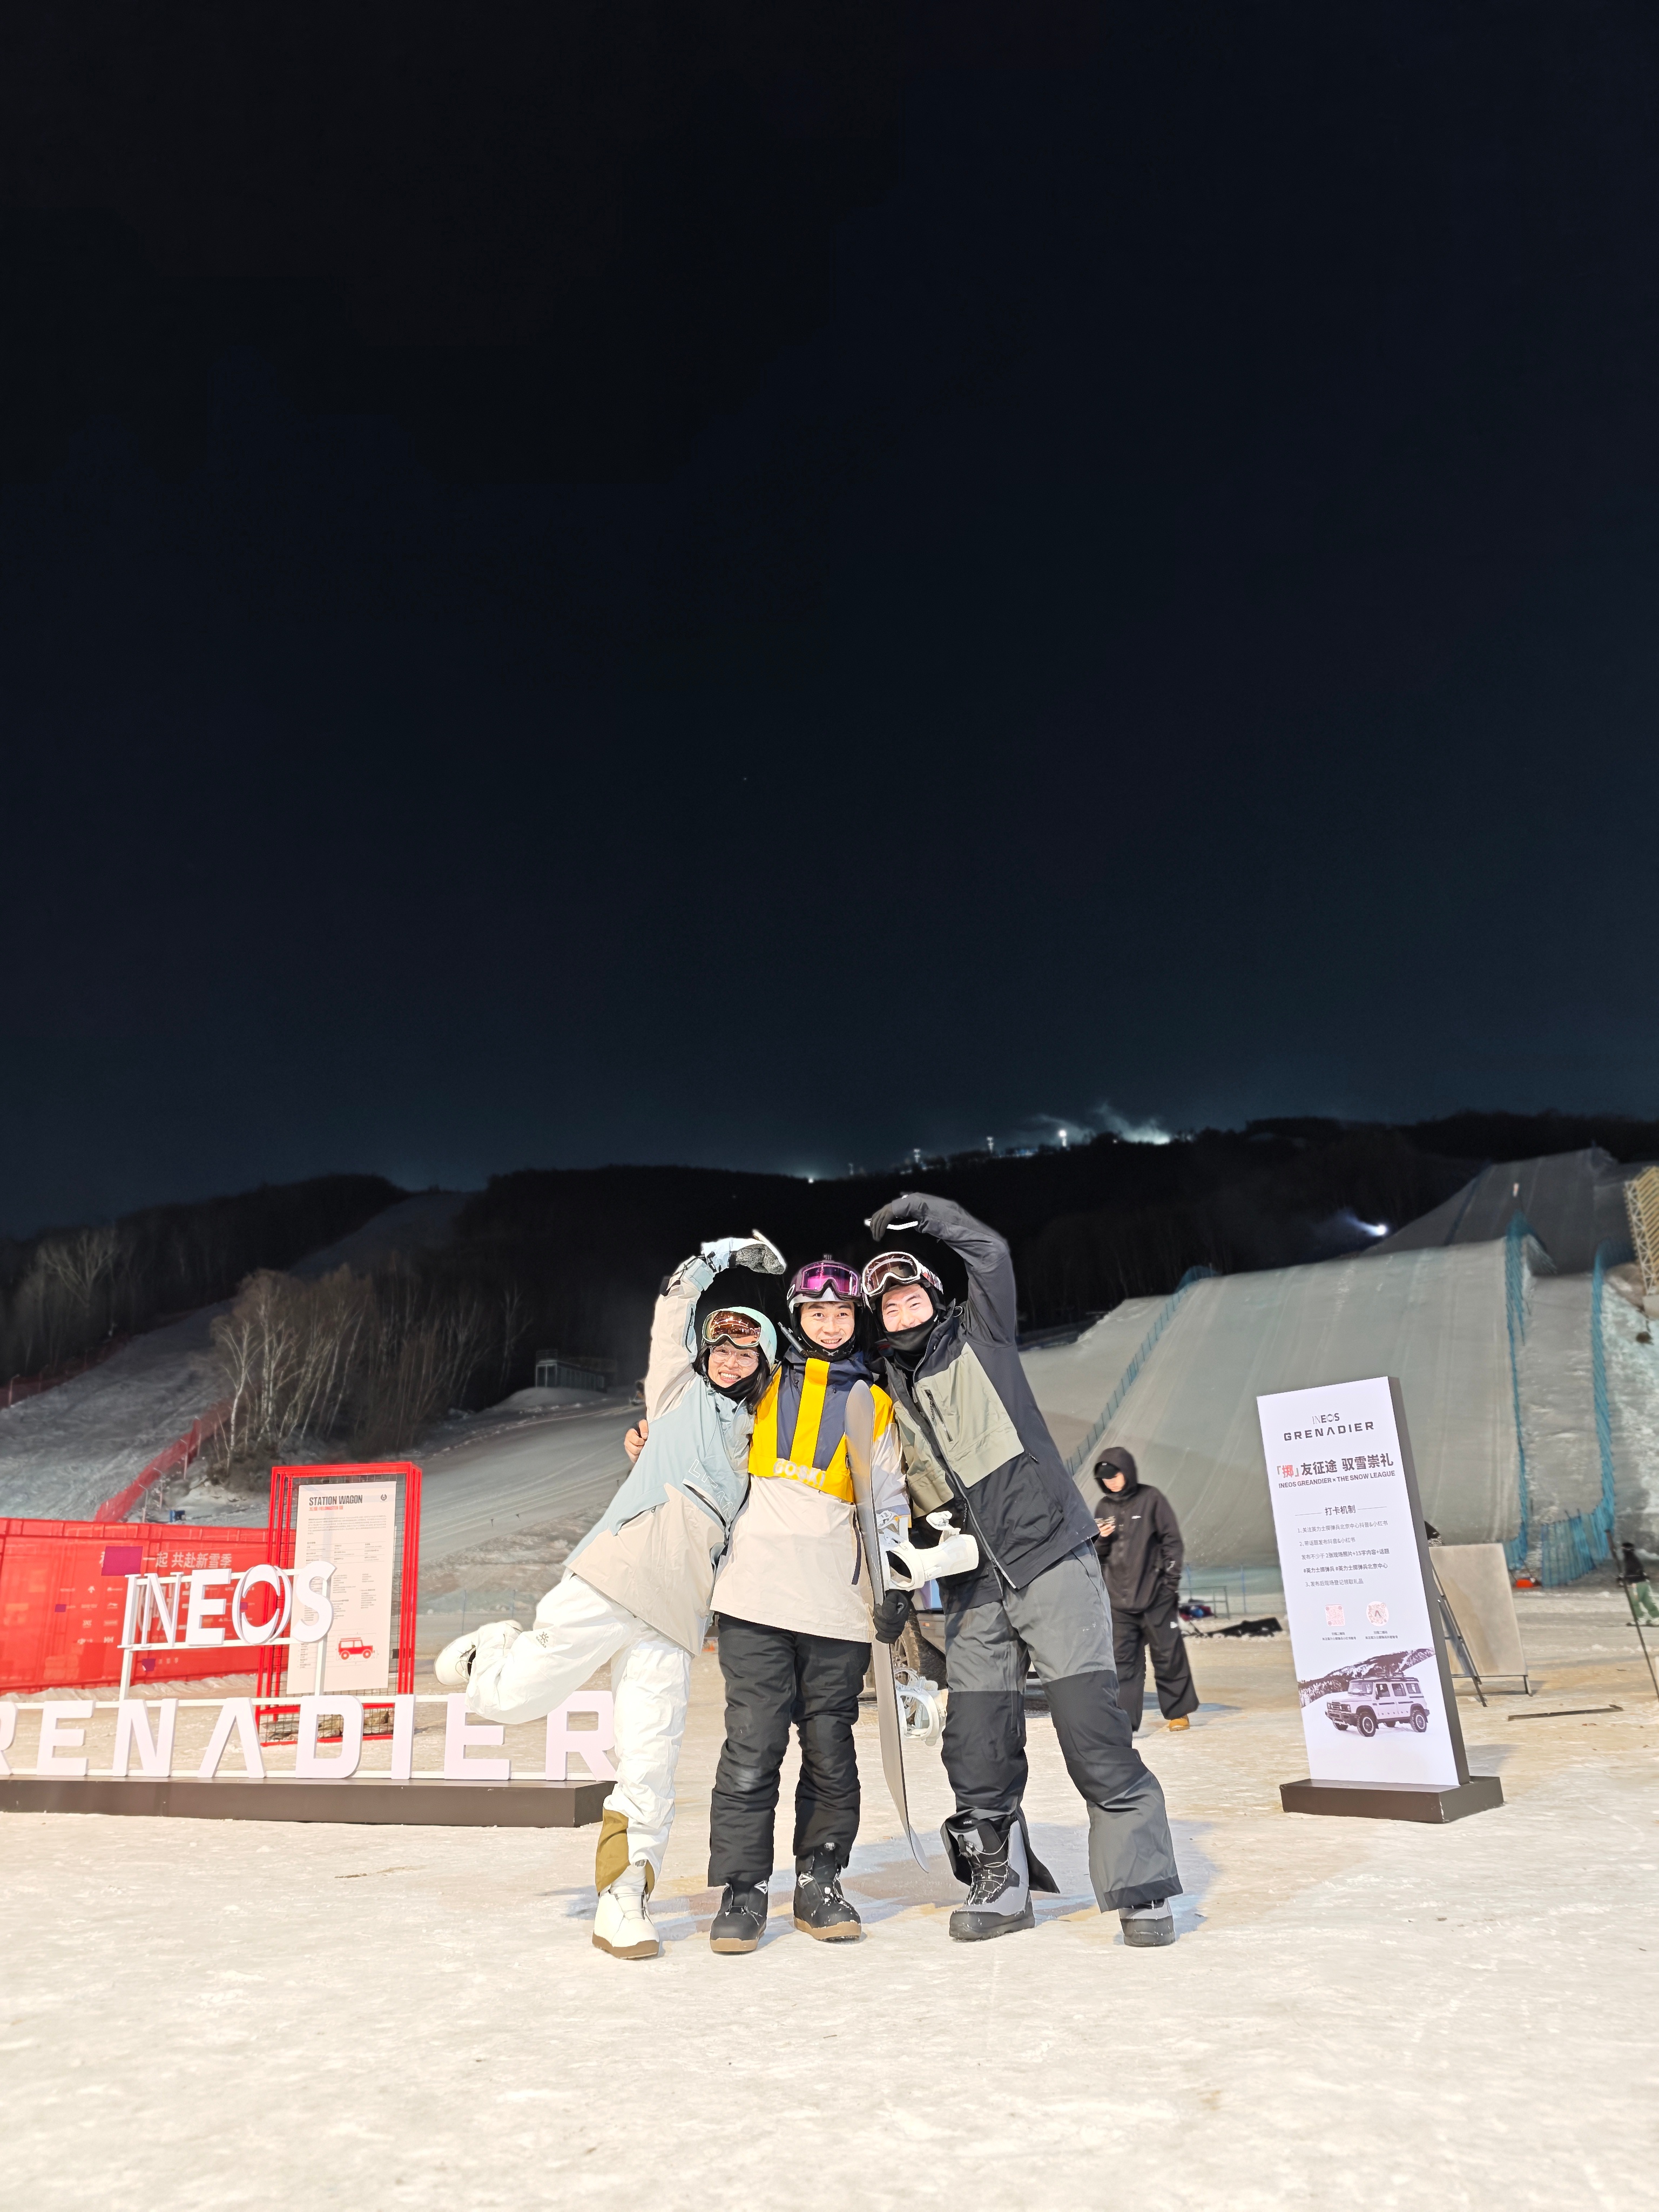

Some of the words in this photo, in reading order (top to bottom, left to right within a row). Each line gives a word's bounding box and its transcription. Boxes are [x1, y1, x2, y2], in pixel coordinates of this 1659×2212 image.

[1312, 1413, 1340, 1425] INEOS
[1284, 1421, 1374, 1441] GRENADIER
[1341, 1453, 1394, 1472] 驭雪崇礼
[773, 1460, 826, 1487] GOSKI
[1370, 1470, 1395, 1479] LEAGUE
[309, 1496, 337, 1506] STATION
[339, 1494, 363, 1504] WAGON
[1325, 1505, 1356, 1516] 打卡机制
[143, 1552, 168, 1568] 一起
[171, 1552, 232, 1568] 共赴新雪季
[117, 1560, 337, 1648] INEOS
